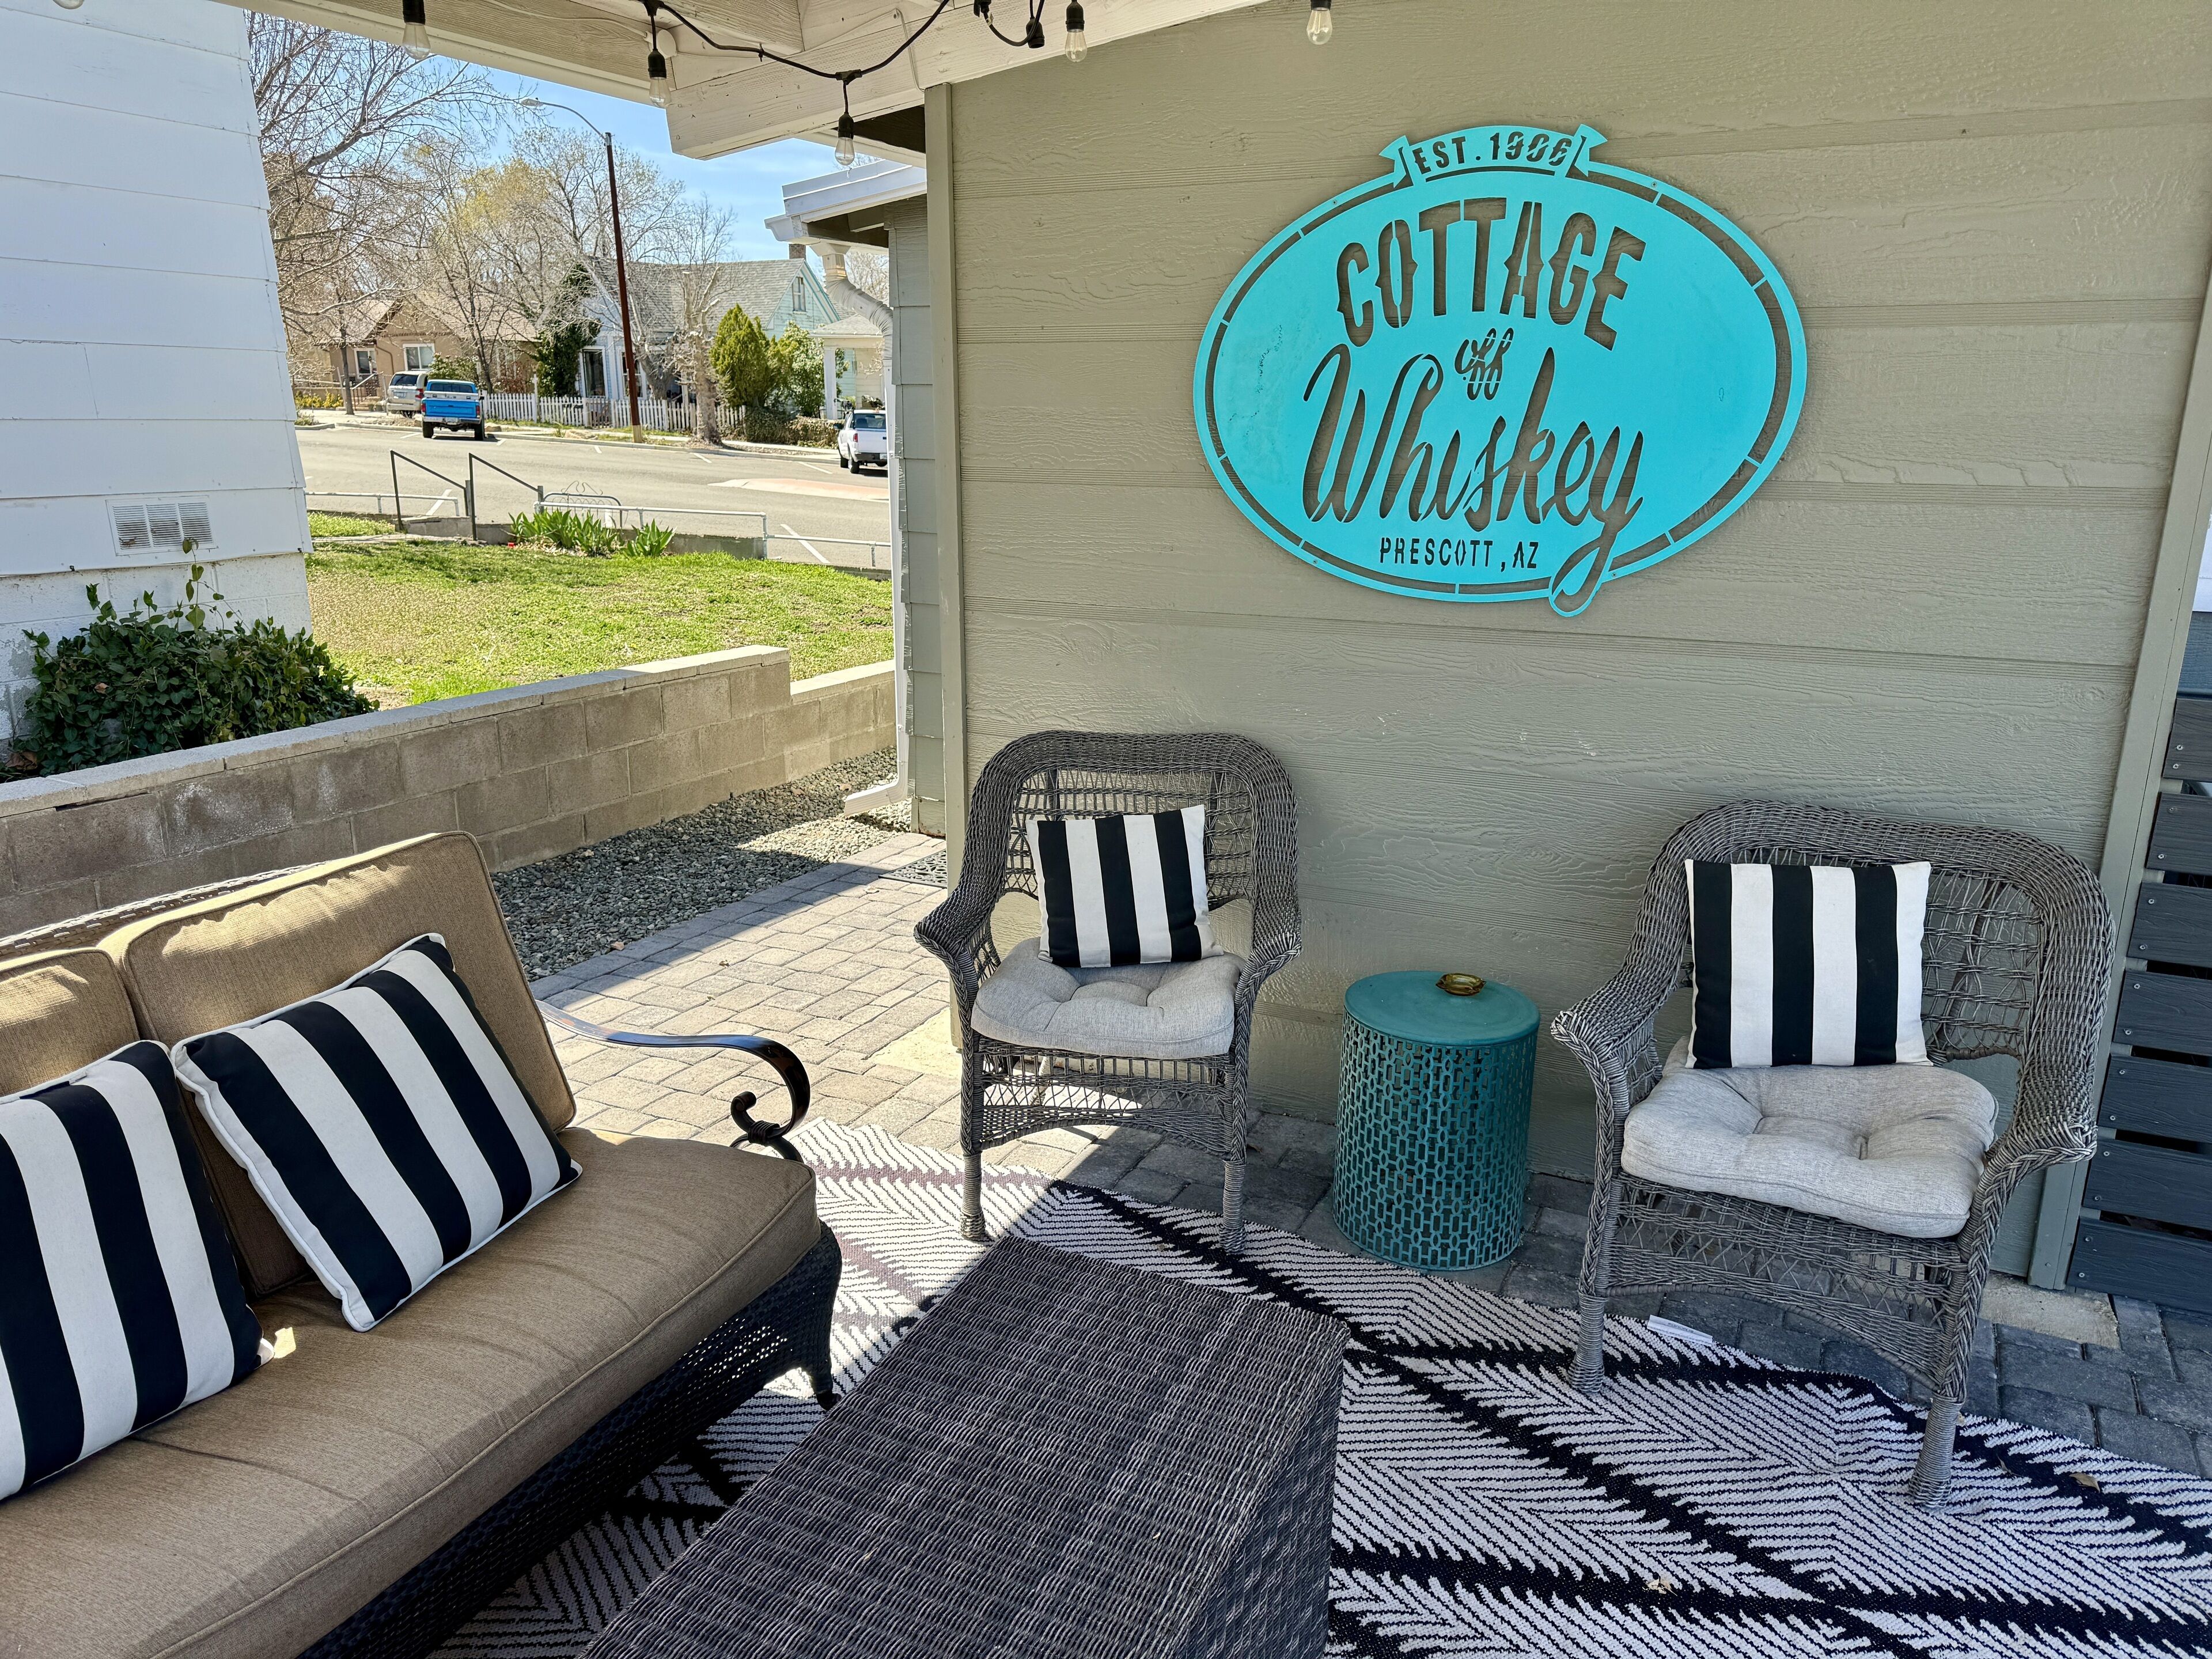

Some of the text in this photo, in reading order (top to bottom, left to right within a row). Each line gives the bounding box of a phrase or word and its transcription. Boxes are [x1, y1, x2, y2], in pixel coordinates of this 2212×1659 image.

[1336, 197, 1646, 350] COTTAGE
[1455, 327, 1514, 400] off
[1302, 343, 1644, 613] Whiskey
[1512, 541, 1539, 569] AZ
